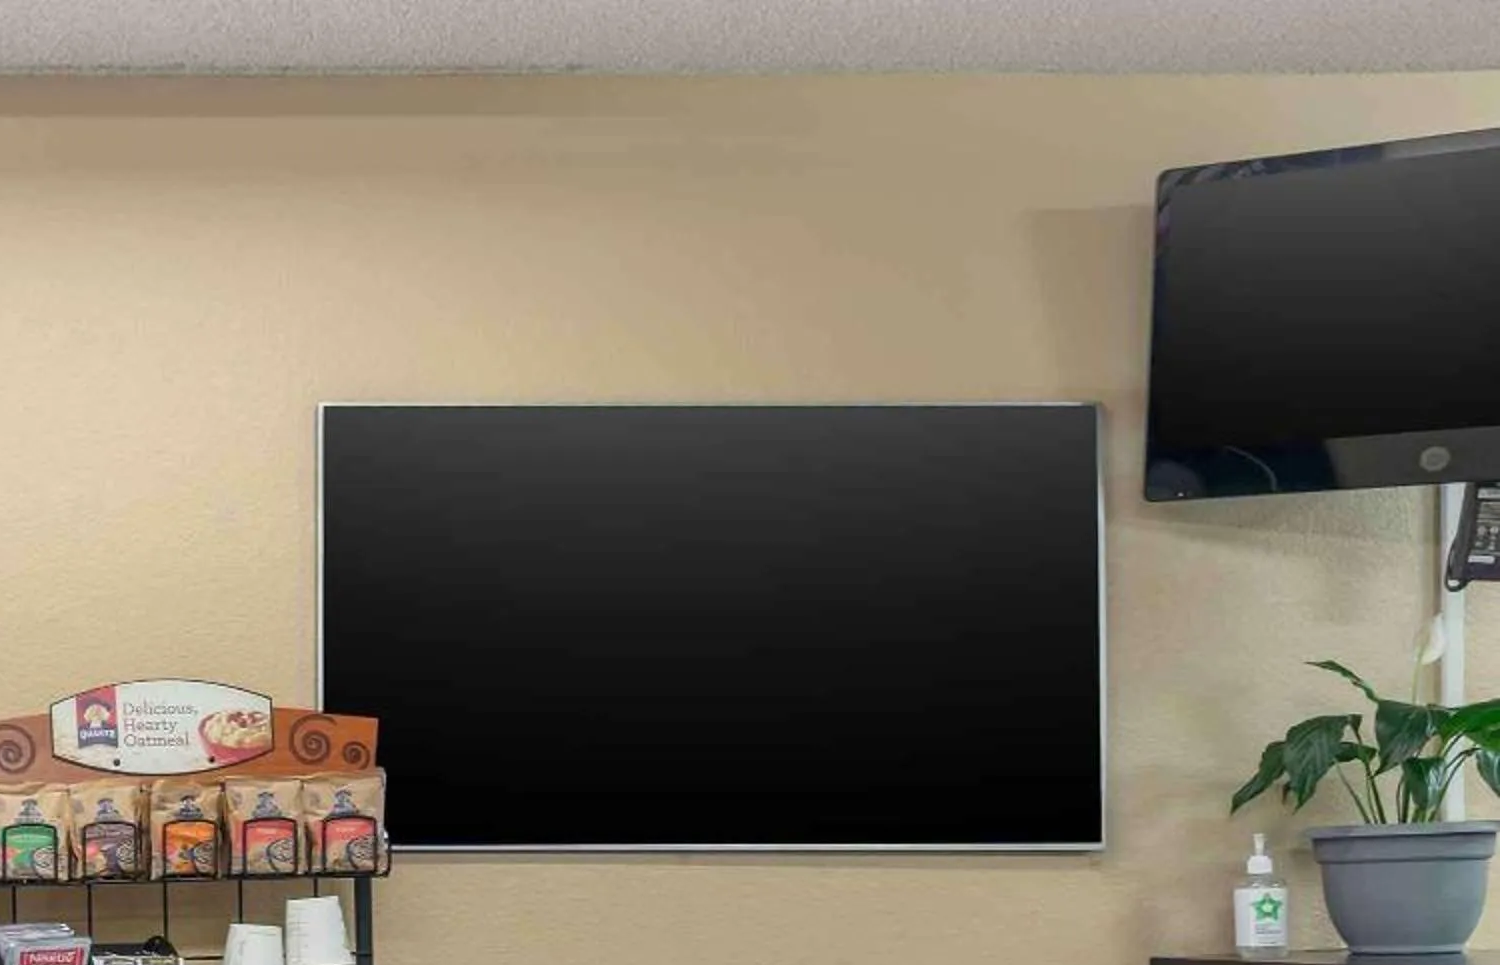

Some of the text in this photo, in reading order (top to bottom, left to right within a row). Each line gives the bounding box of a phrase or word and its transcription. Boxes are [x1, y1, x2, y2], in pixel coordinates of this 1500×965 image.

[123, 700, 199, 716] Delicious,
[123, 718, 178, 734] Hearty
[123, 731, 190, 747] Oatmeal
